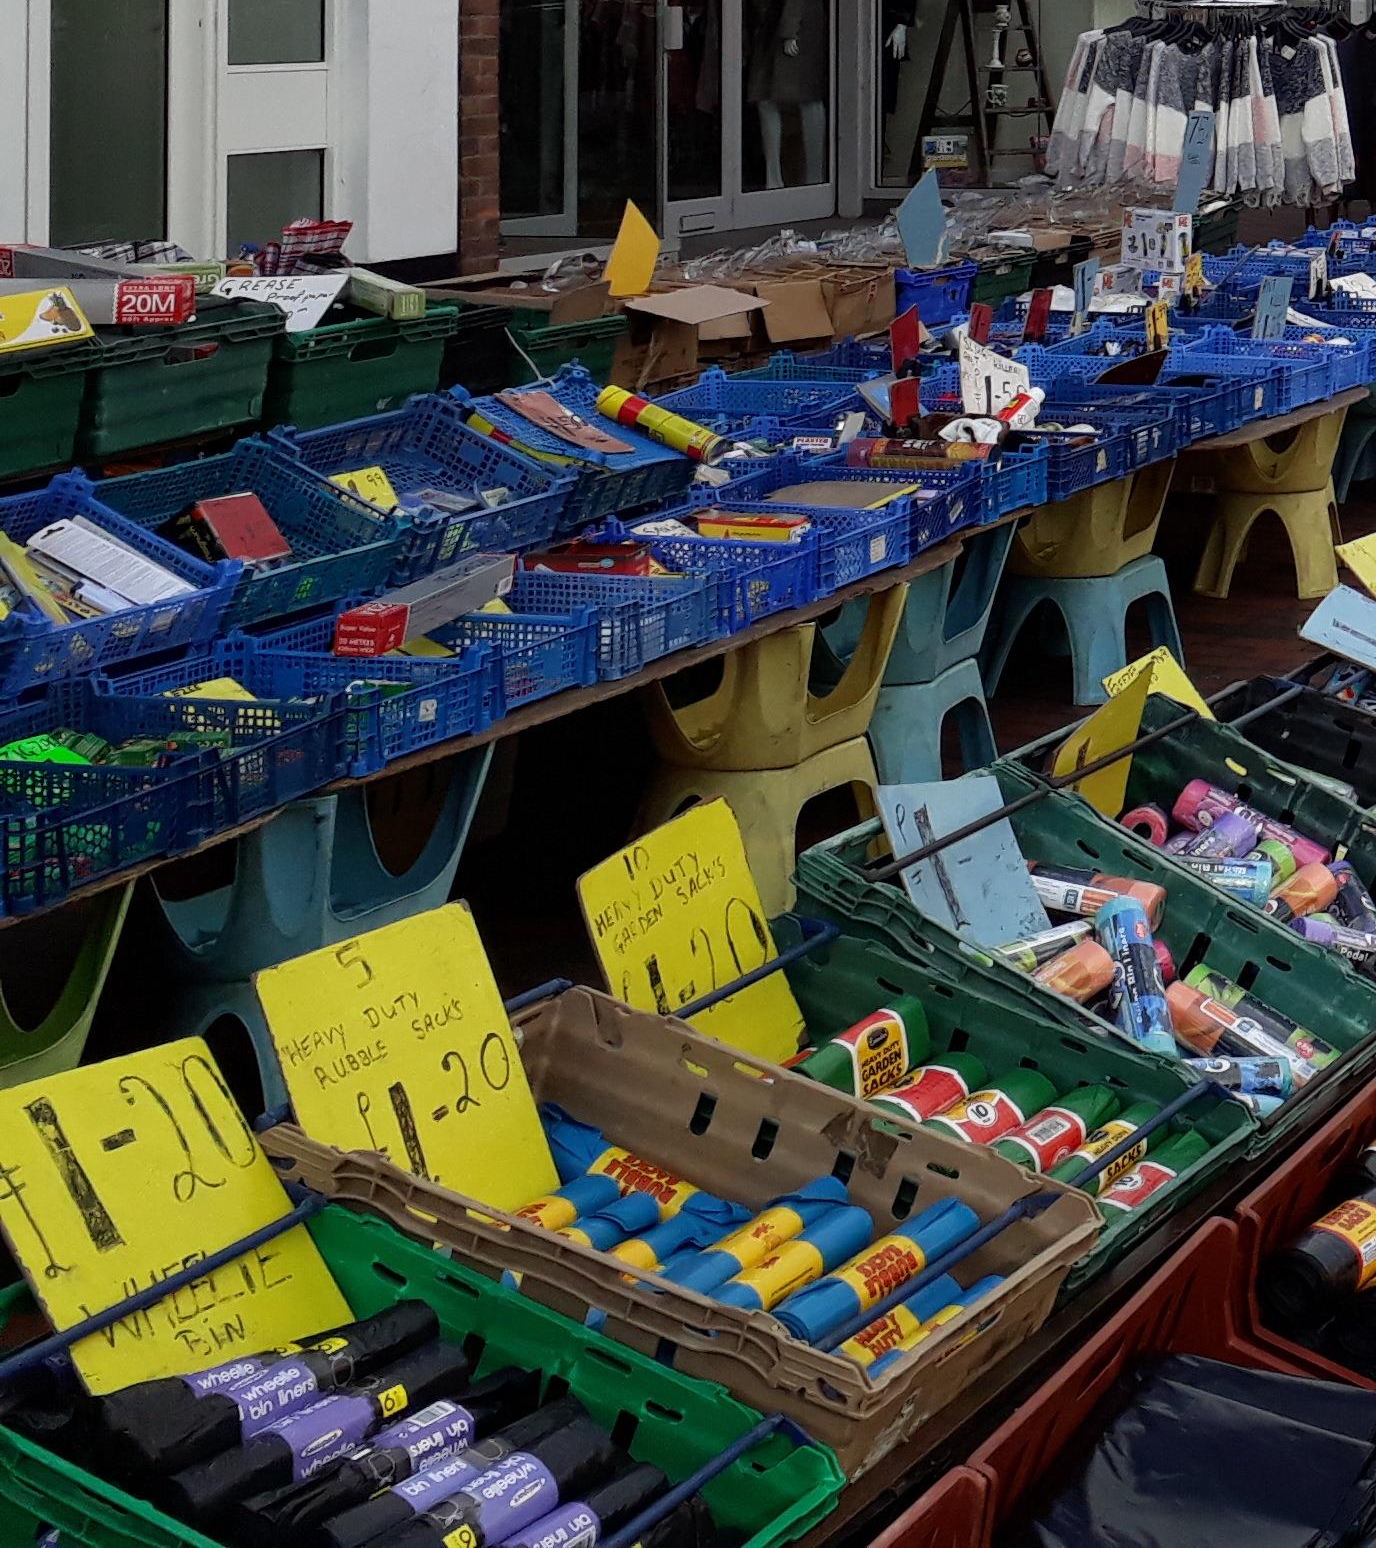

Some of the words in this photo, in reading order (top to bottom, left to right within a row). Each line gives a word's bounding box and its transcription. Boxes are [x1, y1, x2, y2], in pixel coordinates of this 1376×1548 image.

[121, 293, 176, 314] 20M
[218, 278, 303, 295] GREASE
[650, 852, 700, 901] DUTY
[335, 940, 373, 989] 5
[363, 992, 421, 1029] DUTY
[312, 1039, 389, 1090] RUBBLE
[861, 1051, 902, 1083] GARDEN
[862, 1063, 903, 1097] SACKS
[970, 1104, 989, 1119] 10
[1107, 1143, 1143, 1178] SACKS
[603, 1157, 678, 1205] RUBBLE
[863, 1250, 919, 1300] RUBBLE
[175, 1314, 245, 1356] BIN
[867, 1326, 904, 1359] DUTY
[197, 1362, 255, 1390] wheelie
[241, 1367, 301, 1403] wheelie
[249, 1399, 274, 1421] bin
[277, 1378, 316, 1408] liners
[409, 1431, 445, 1458] liners
[445, 1419, 469, 1438] bin
[482, 1462, 538, 1500] wheelie
[568, 1513, 593, 1532] bin
